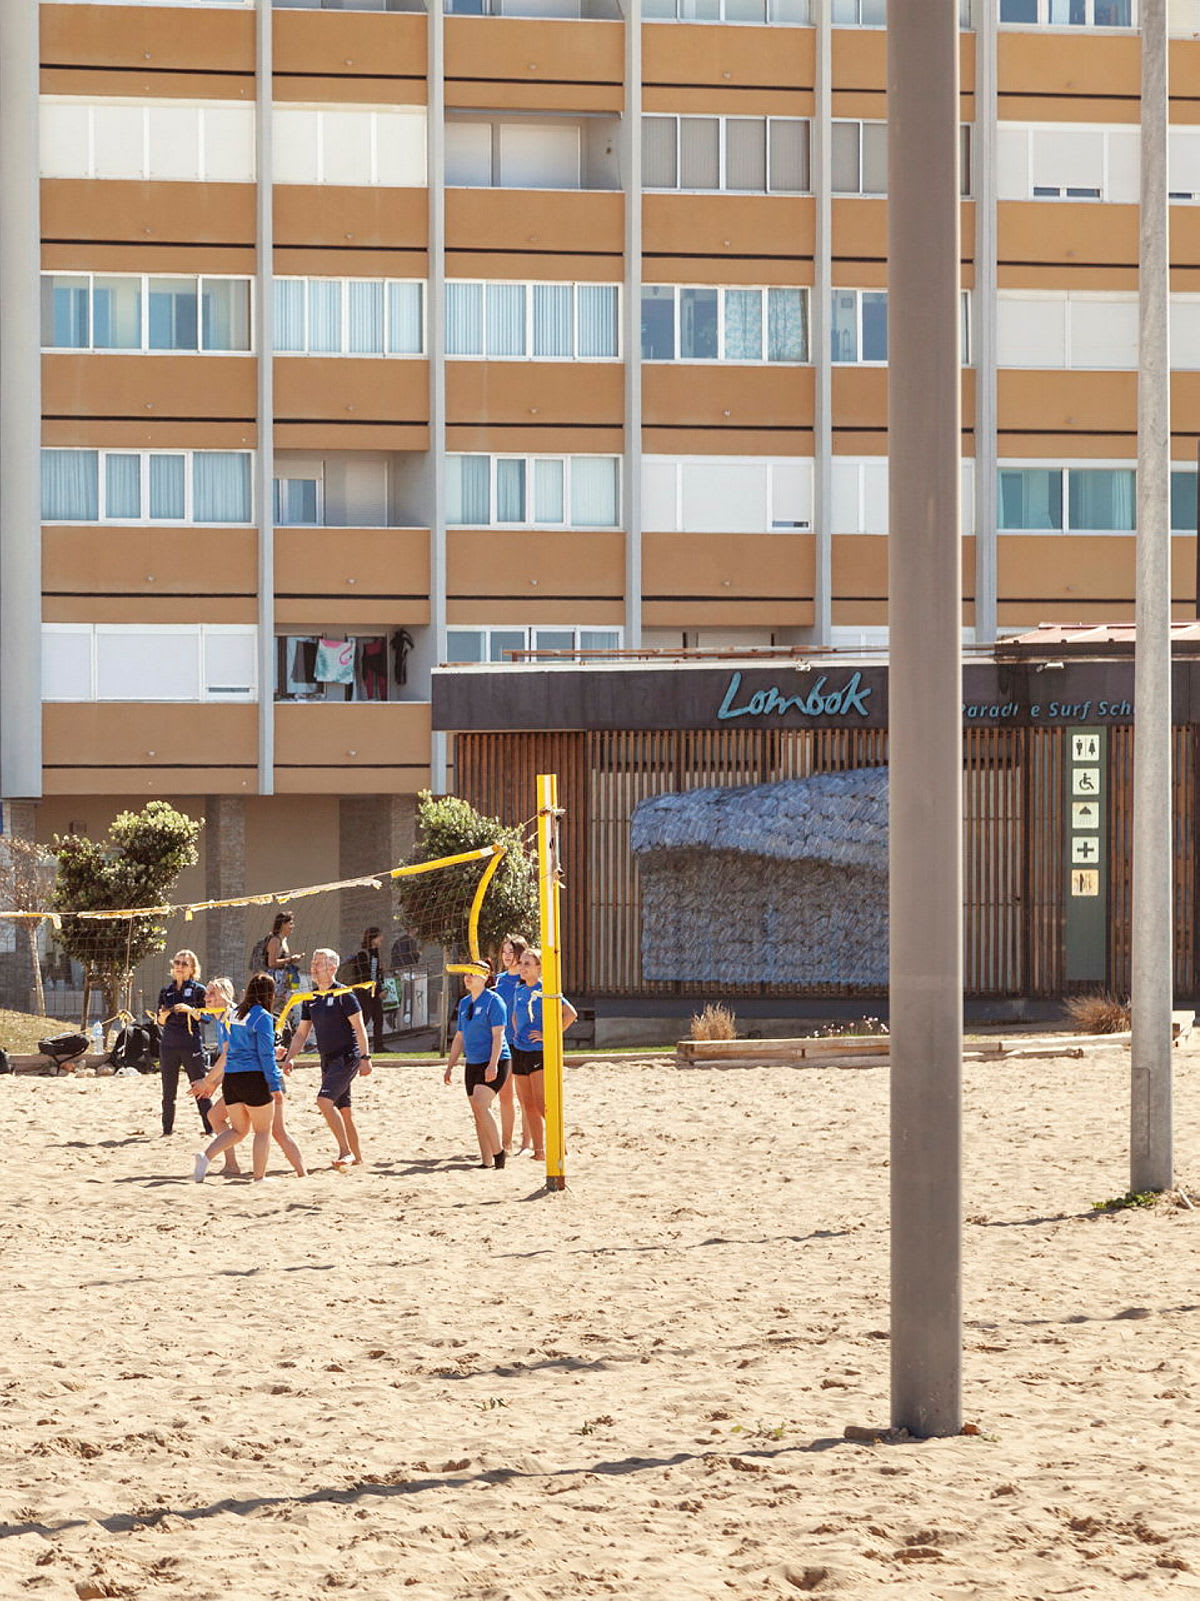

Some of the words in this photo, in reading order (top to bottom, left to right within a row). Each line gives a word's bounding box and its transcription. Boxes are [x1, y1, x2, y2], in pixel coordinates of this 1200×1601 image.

[717, 671, 872, 720] Lombok
[1049, 701, 1092, 719] Surf
[1098, 700, 1136, 716] Sch
